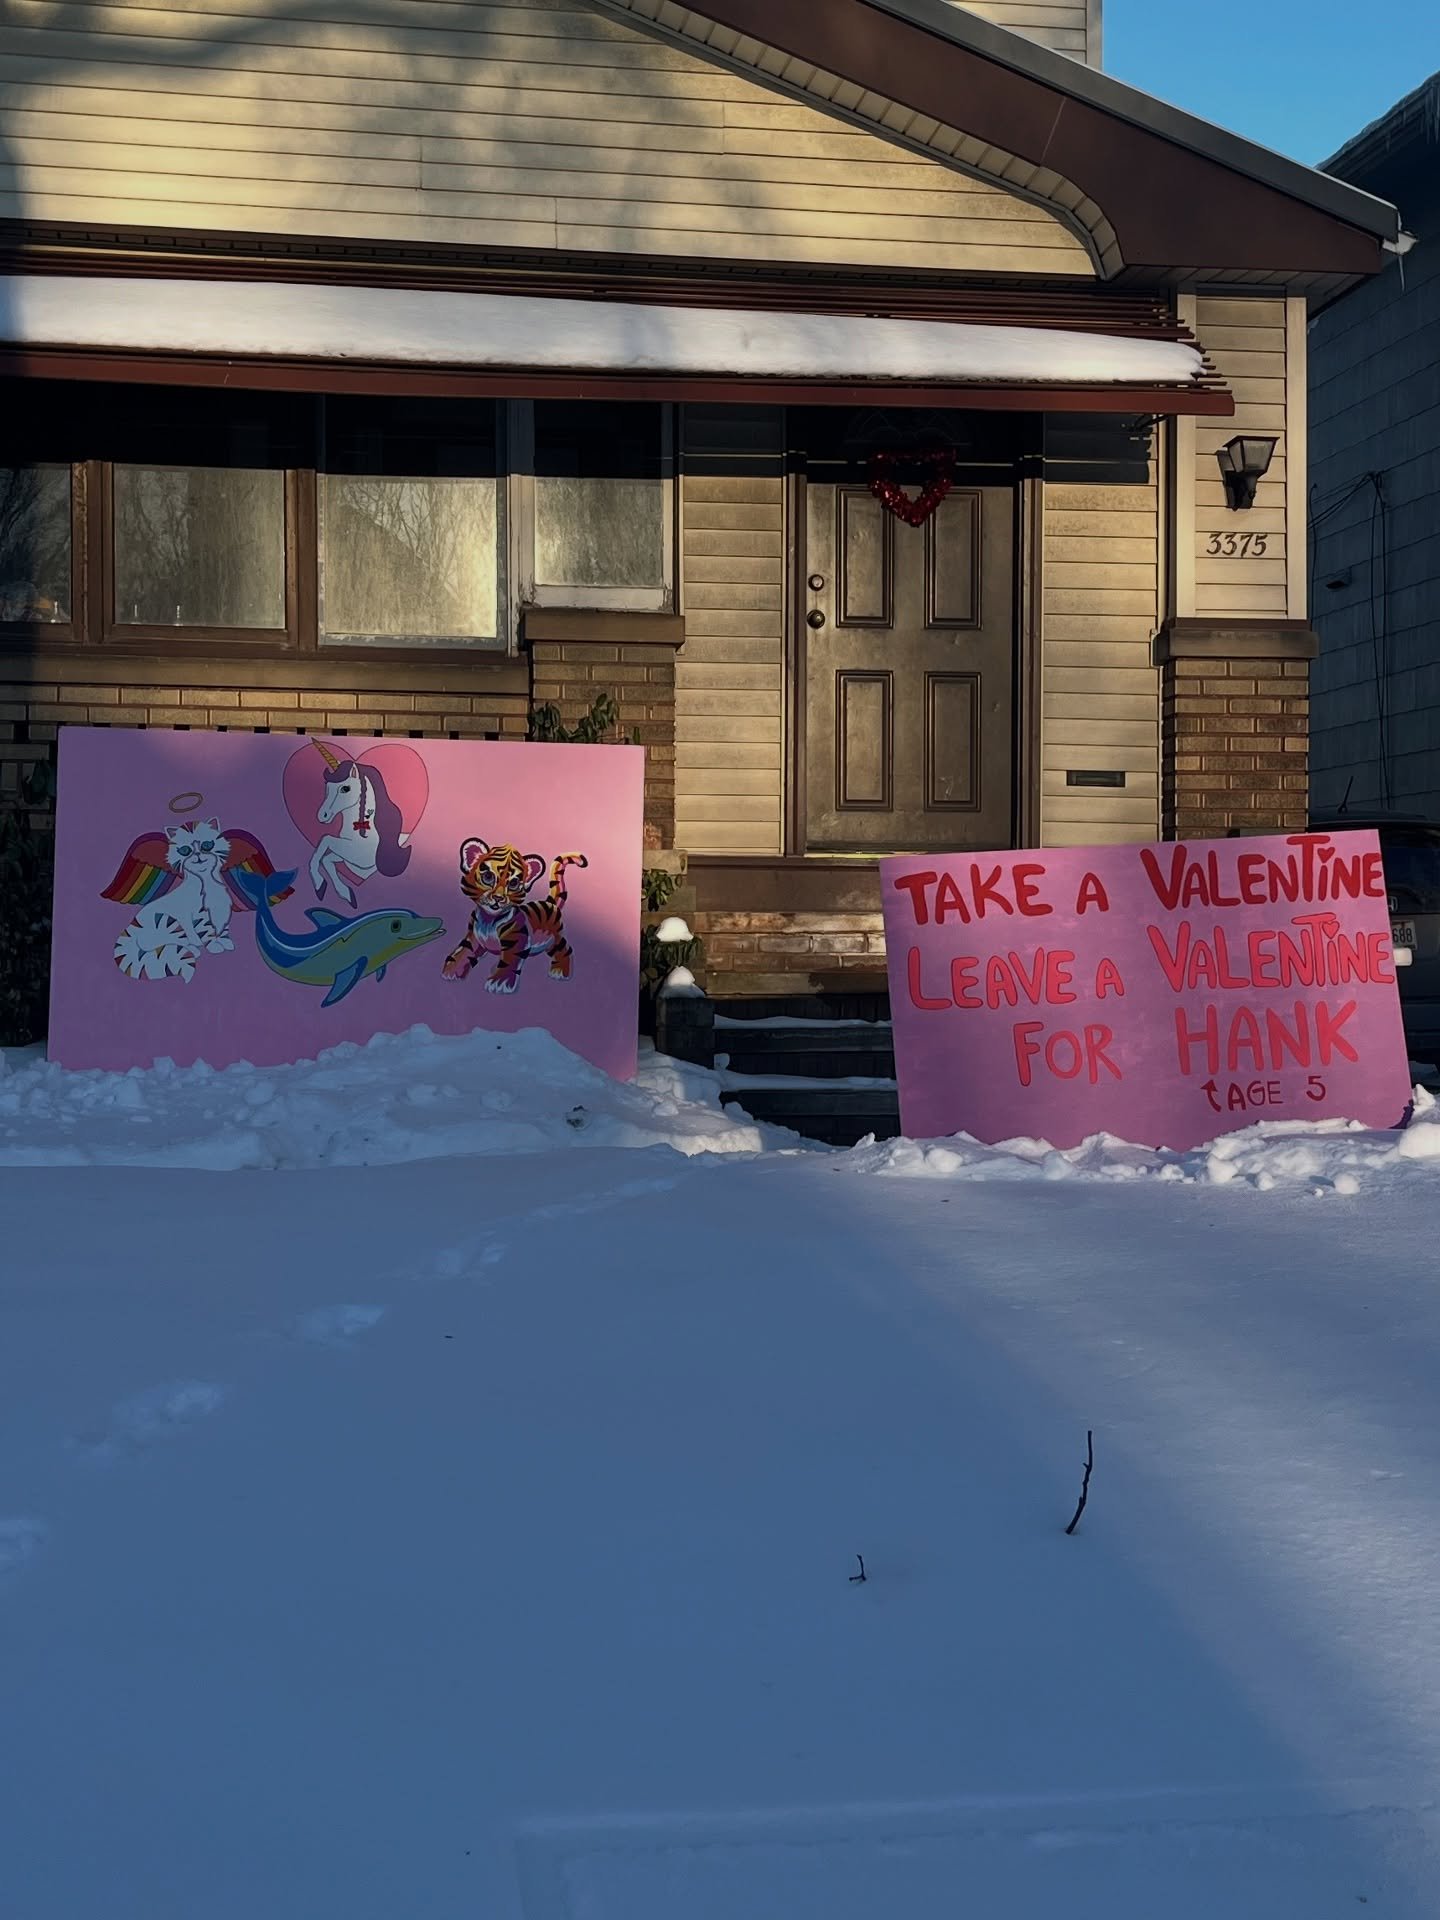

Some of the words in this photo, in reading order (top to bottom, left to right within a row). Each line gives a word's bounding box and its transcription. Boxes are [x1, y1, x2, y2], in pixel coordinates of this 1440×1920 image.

[1206, 532, 1268, 558] 3375
[895, 864, 1053, 926] TAKE
[1076, 872, 1110, 915] A
[907, 945, 1077, 1010] LEAVE
[1095, 957, 1125, 999] A
[1013, 1021, 1123, 1087] FOR
[1175, 1000, 1359, 1076] HANK
[1228, 1080, 1283, 1113] AGE
[1306, 1075, 1327, 1102] 5
